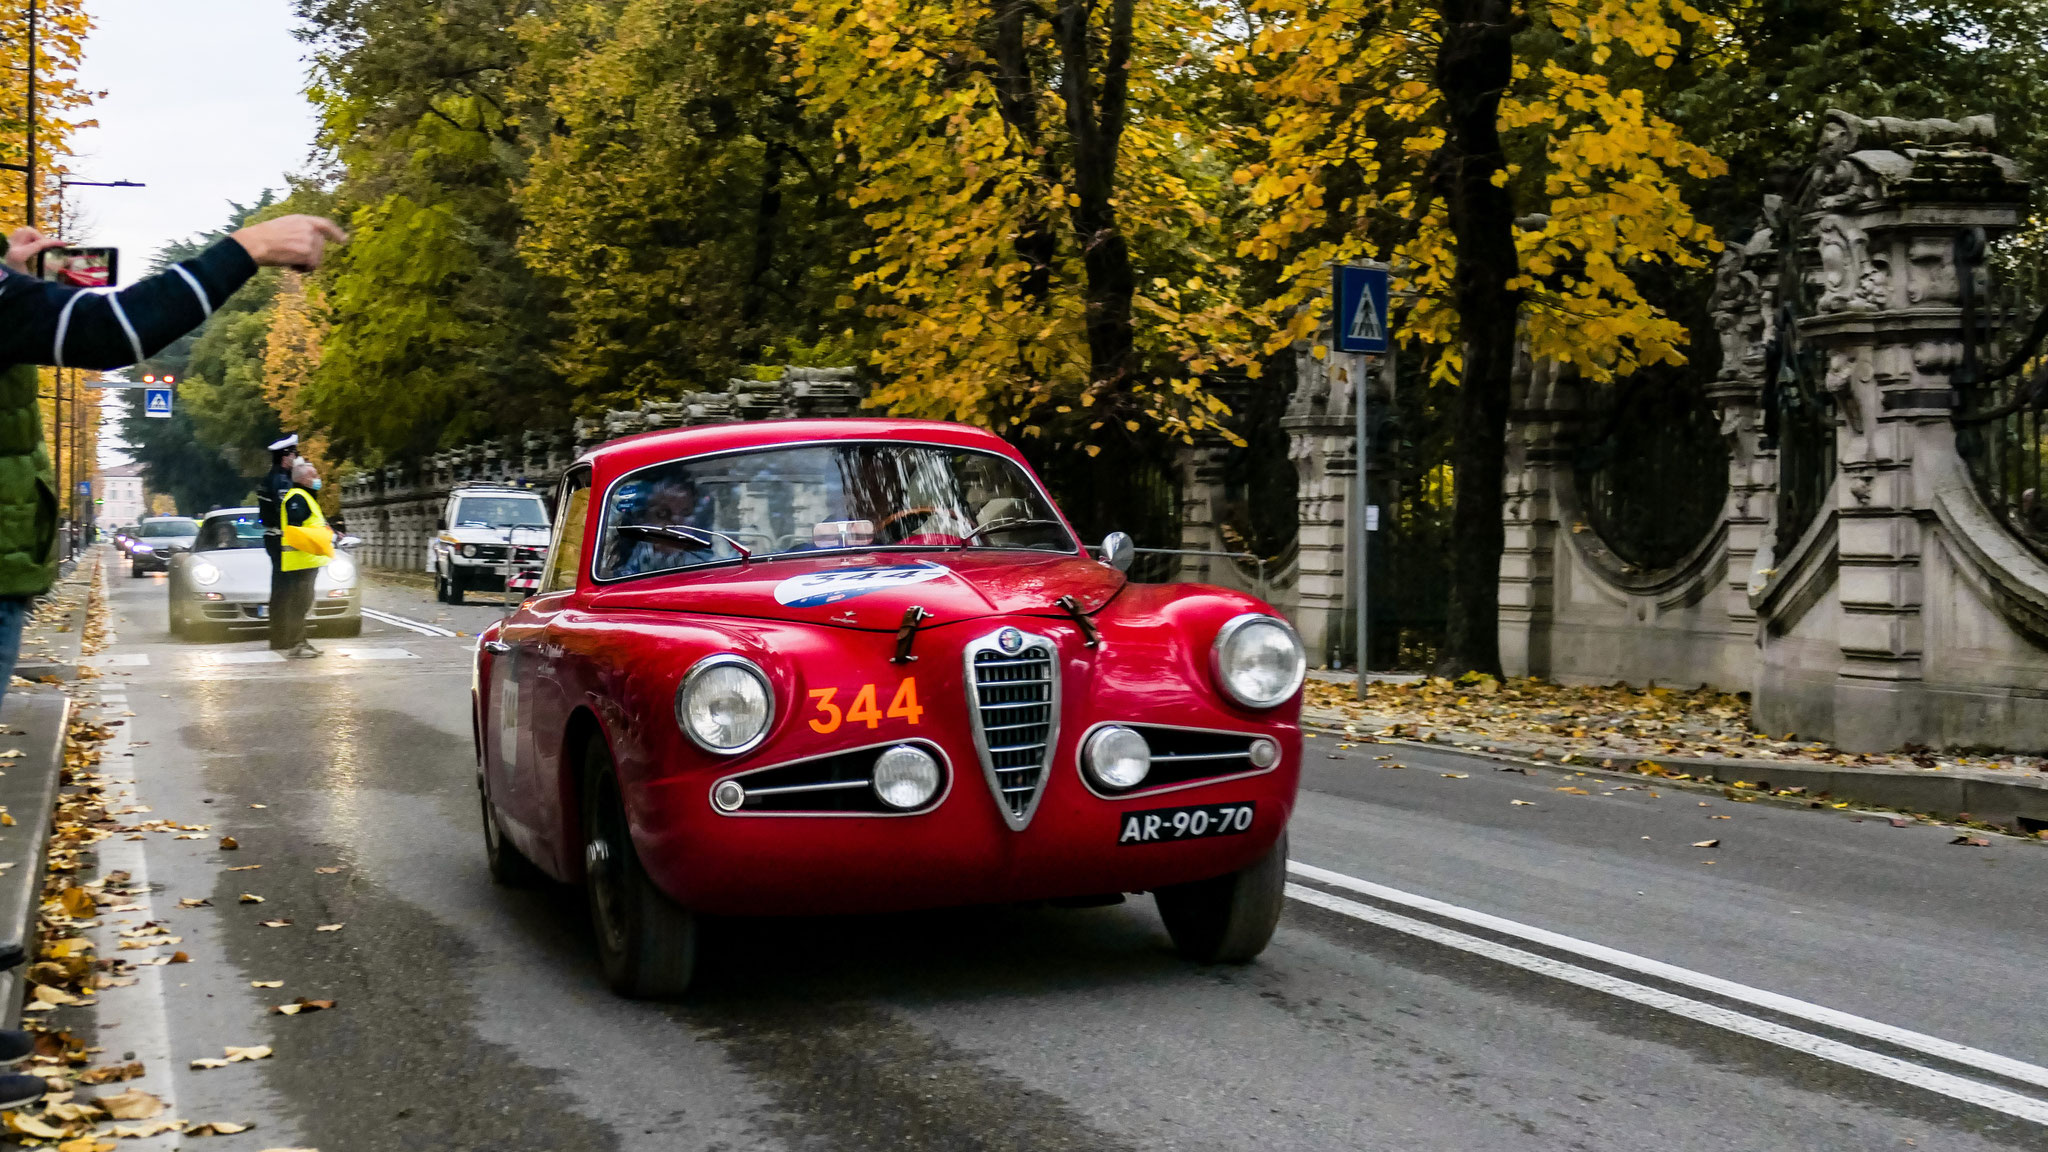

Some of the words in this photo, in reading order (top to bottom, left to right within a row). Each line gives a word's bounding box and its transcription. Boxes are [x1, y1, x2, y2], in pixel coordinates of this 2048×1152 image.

[801, 570, 920, 587] 344
[808, 676, 923, 734] 344
[1119, 806, 1254, 843] AR-90-70
